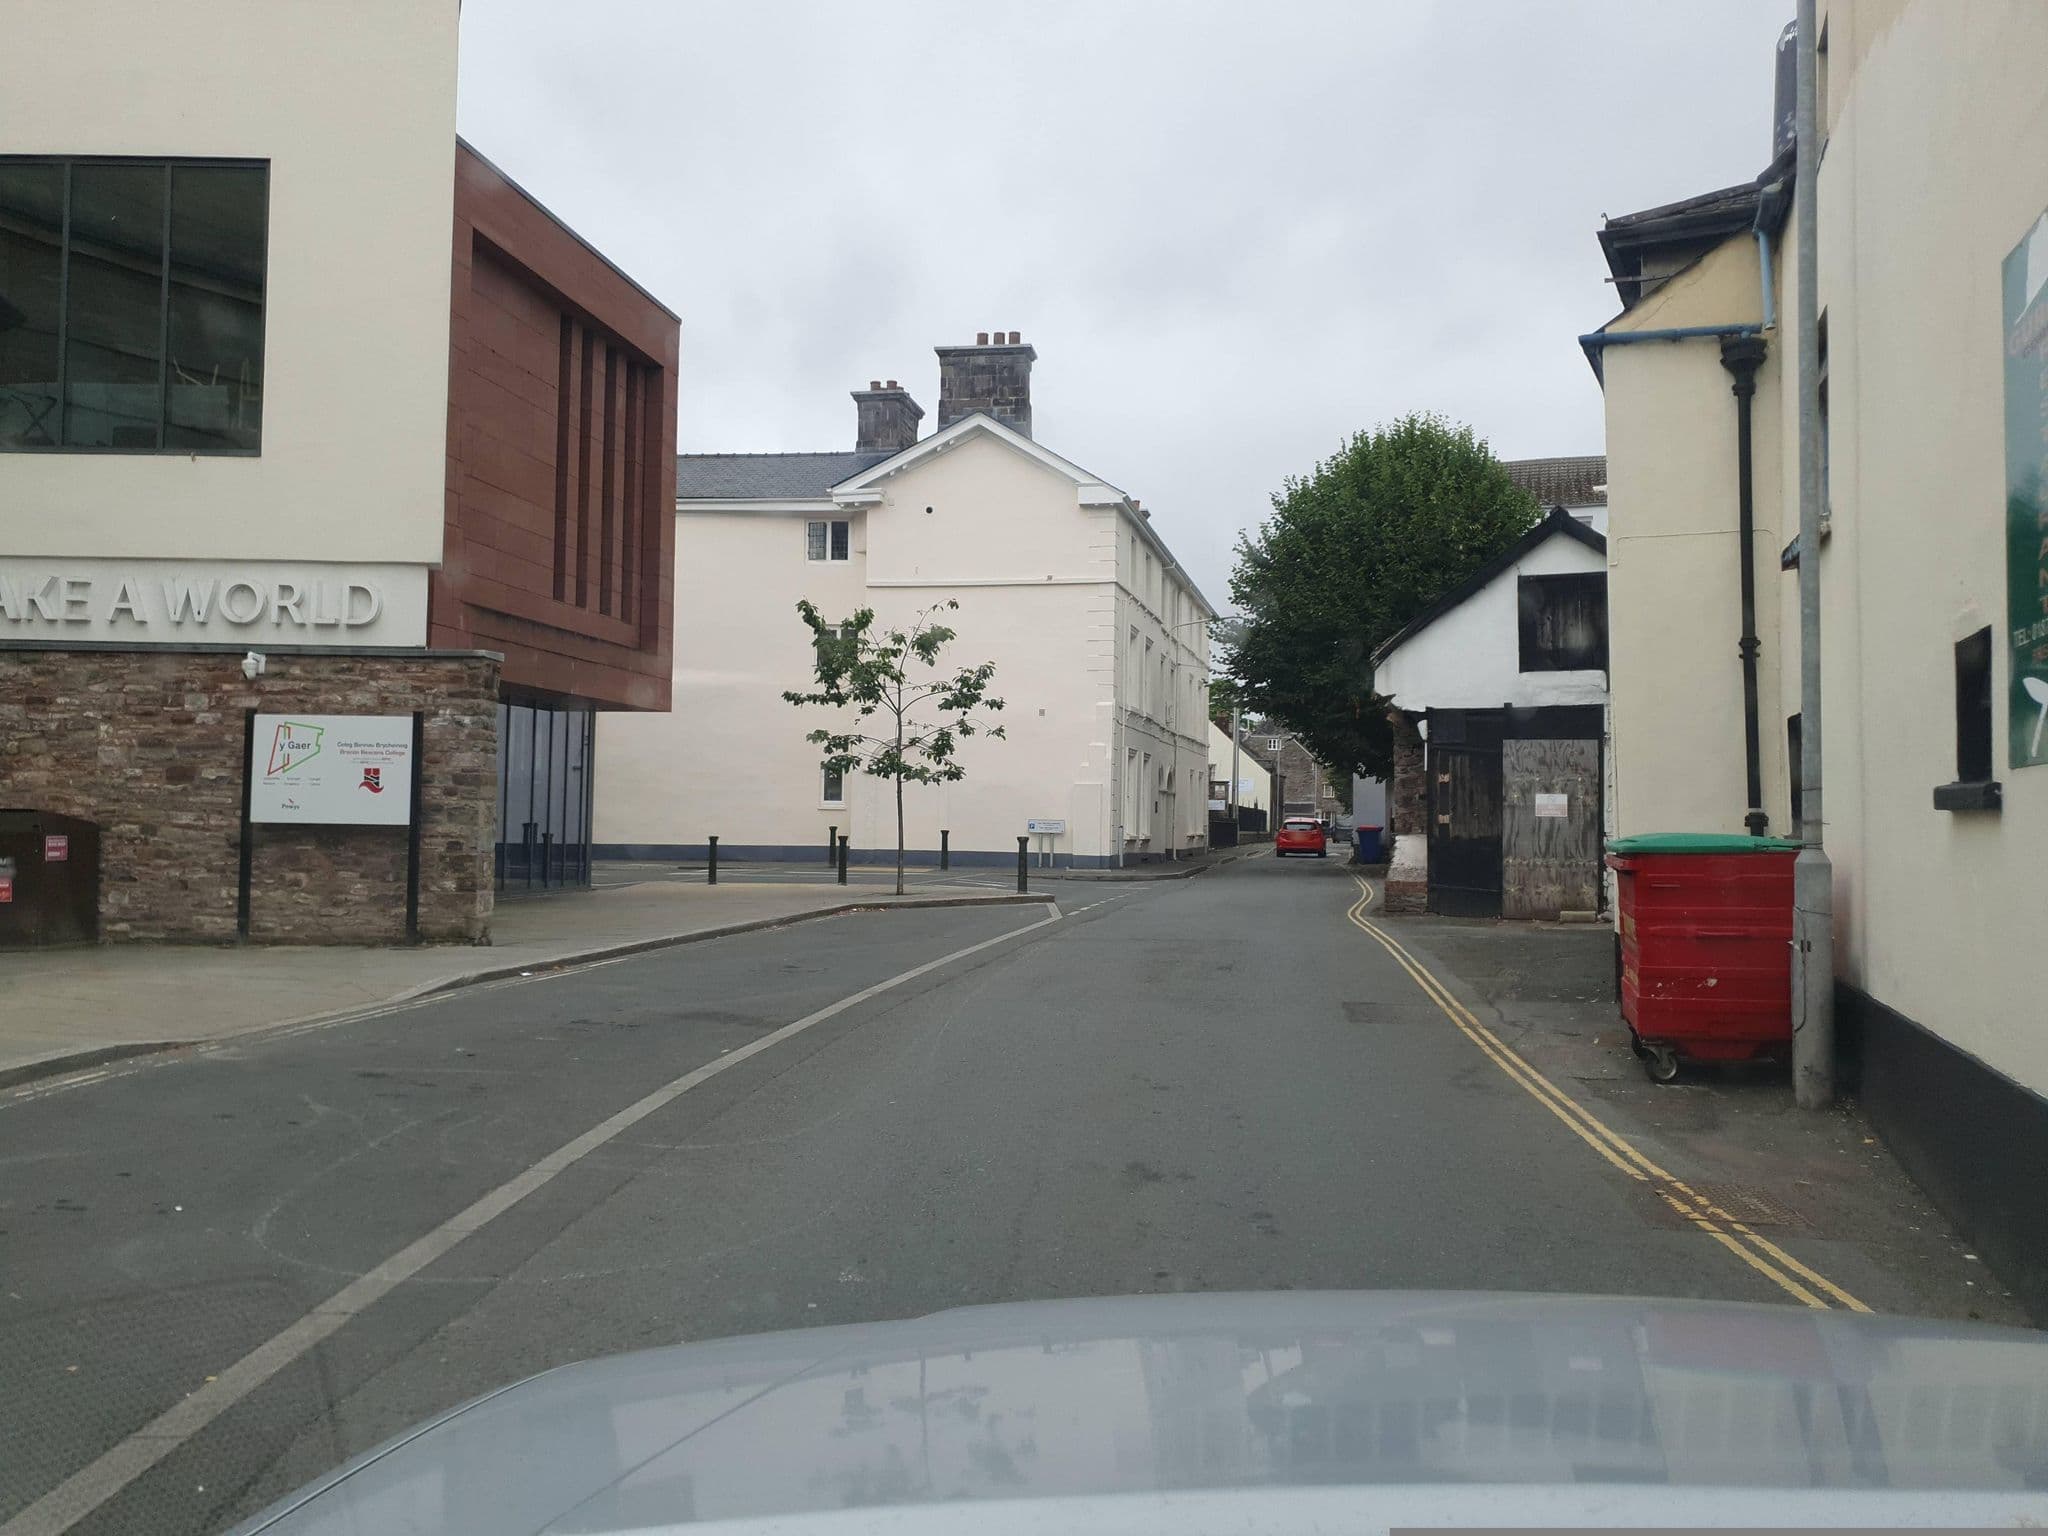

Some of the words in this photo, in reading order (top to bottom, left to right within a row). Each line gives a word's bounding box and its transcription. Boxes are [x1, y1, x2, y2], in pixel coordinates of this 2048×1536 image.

[107, 576, 149, 624] A
[162, 577, 384, 626] WORLD
[279, 742, 286, 751] y
[288, 741, 311, 750] Gaer
